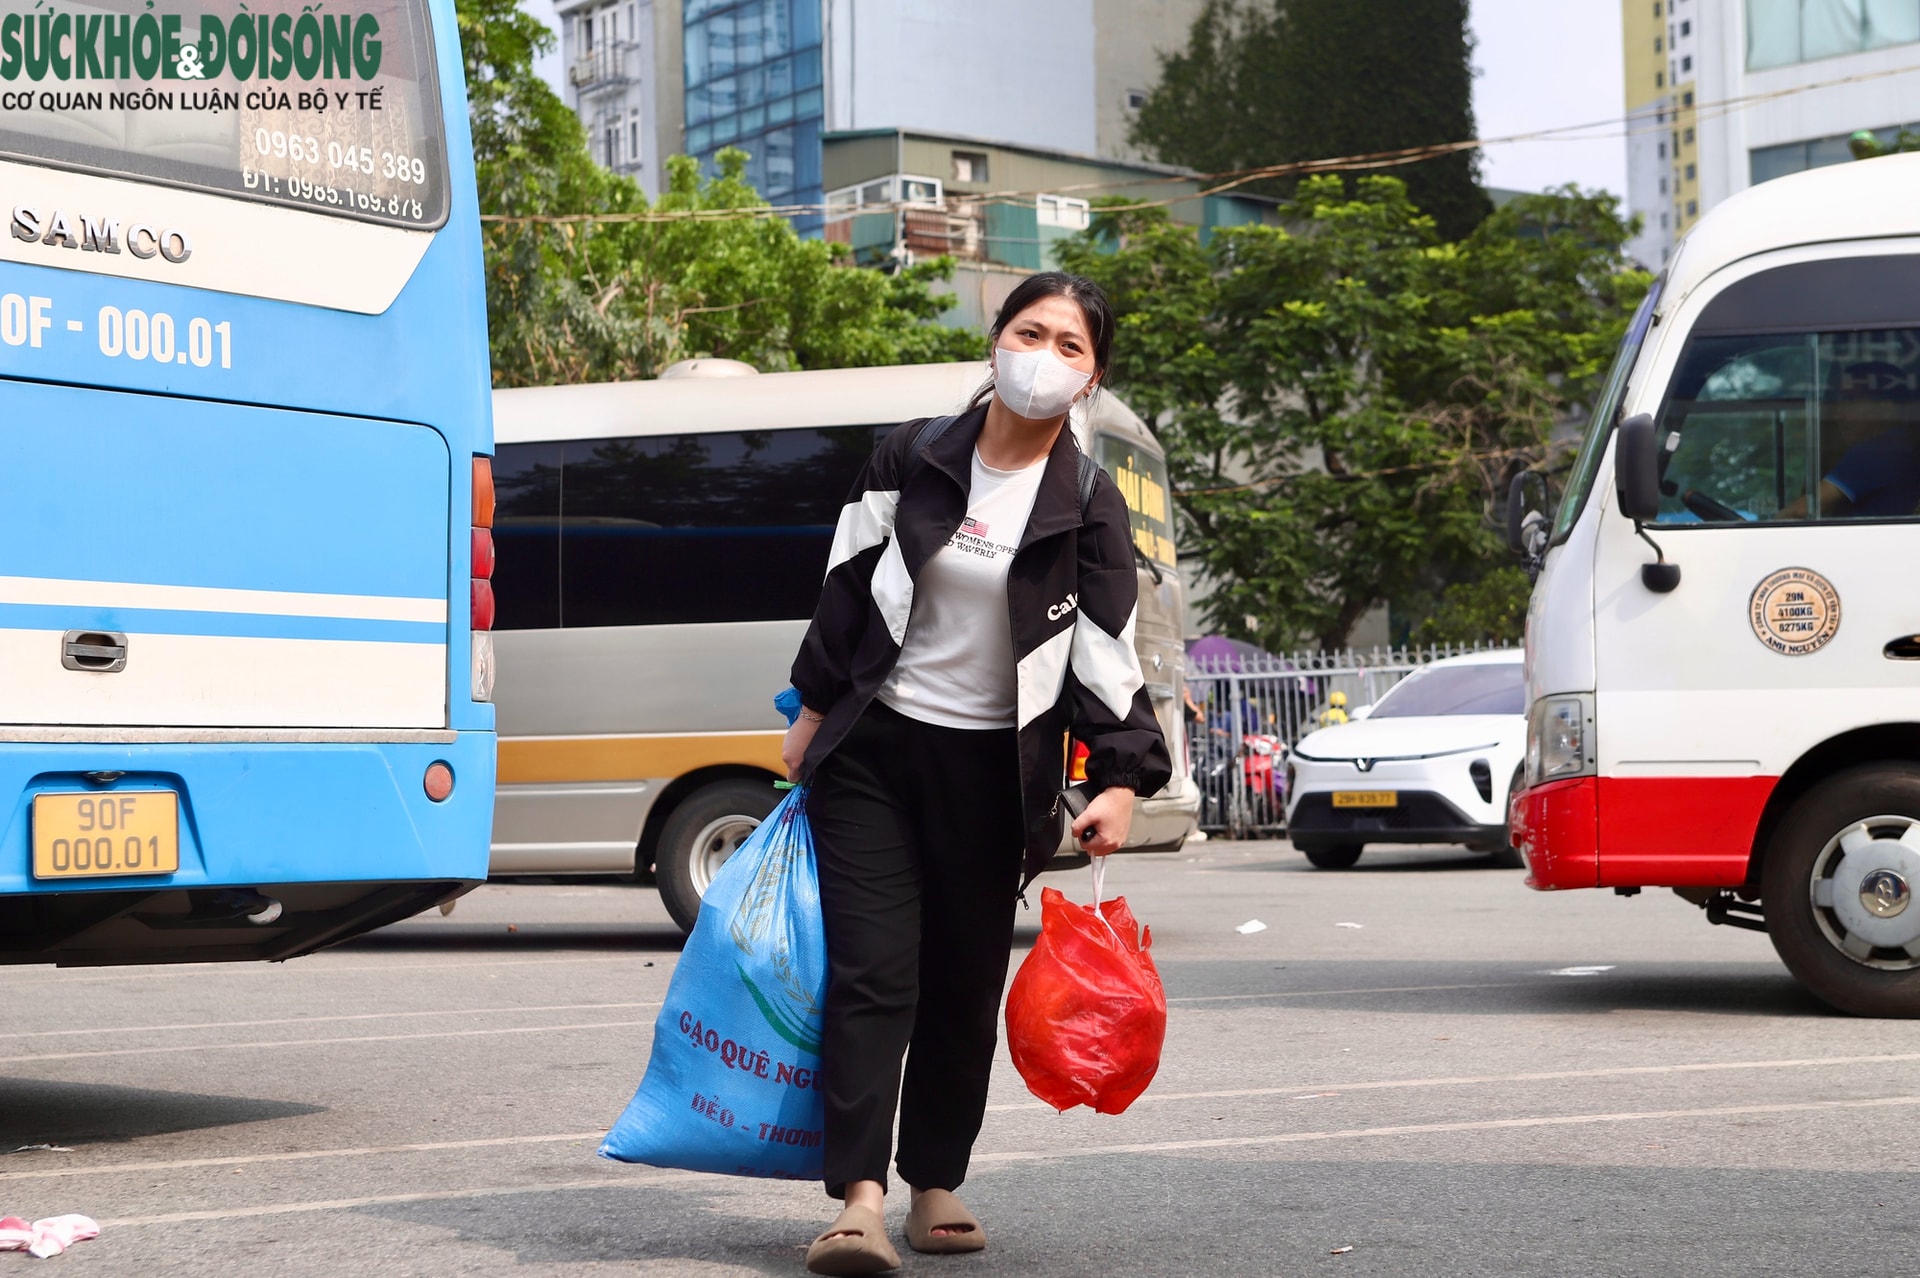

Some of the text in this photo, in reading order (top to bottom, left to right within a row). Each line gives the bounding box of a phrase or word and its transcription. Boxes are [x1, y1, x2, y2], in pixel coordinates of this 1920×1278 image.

[255, 127, 426, 185] 0963 045 389
[11, 204, 193, 264] SAMCO
[98, 305, 232, 369] 000.01
[954, 532, 994, 550] WOMENS
[957, 542, 997, 559] WAVERLY
[77, 797, 137, 831] 90F
[52, 835, 158, 872] 000.01
[719, 1039, 770, 1080] QUÊ
[758, 1122, 823, 1148] THƠM
